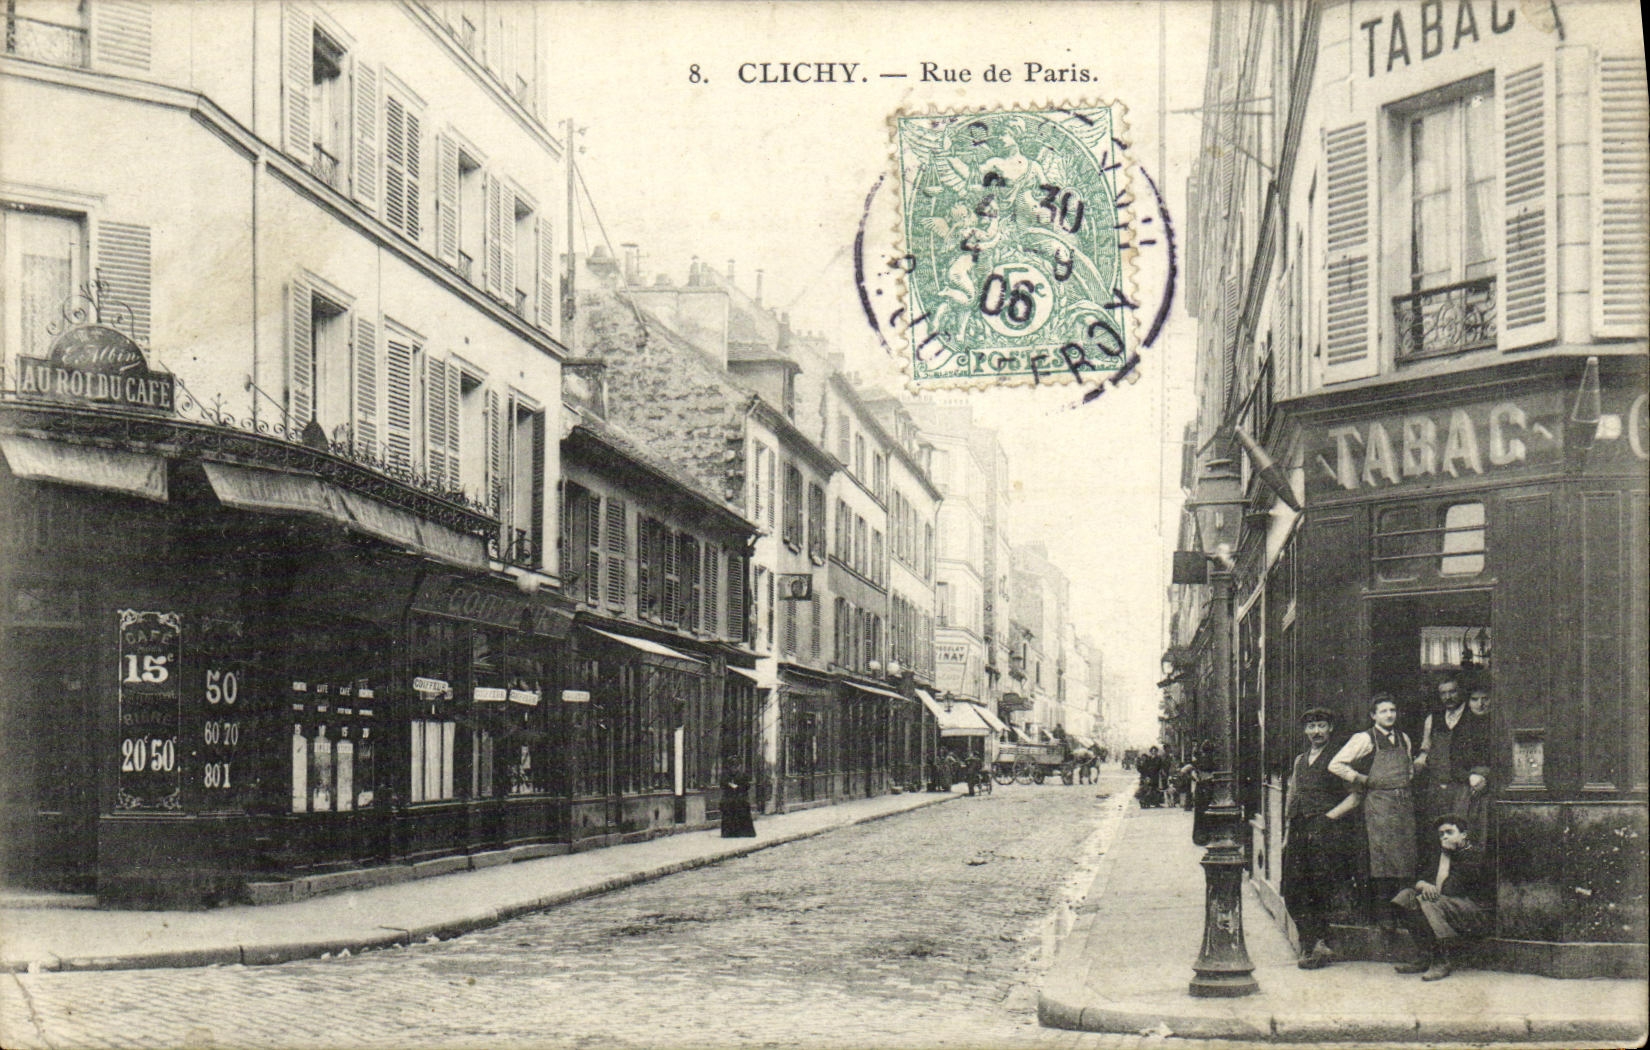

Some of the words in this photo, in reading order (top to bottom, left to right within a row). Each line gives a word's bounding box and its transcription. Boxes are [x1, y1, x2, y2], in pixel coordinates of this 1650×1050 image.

[1360, 0, 1515, 77] TABAC
[979, 273, 1034, 323] 06
[22, 365, 52, 394] AU
[56, 368, 93, 399] ROI
[97, 373, 122, 401] DU
[972, 347, 1066, 374] POSTES
[1327, 402, 1527, 490] TABAC
